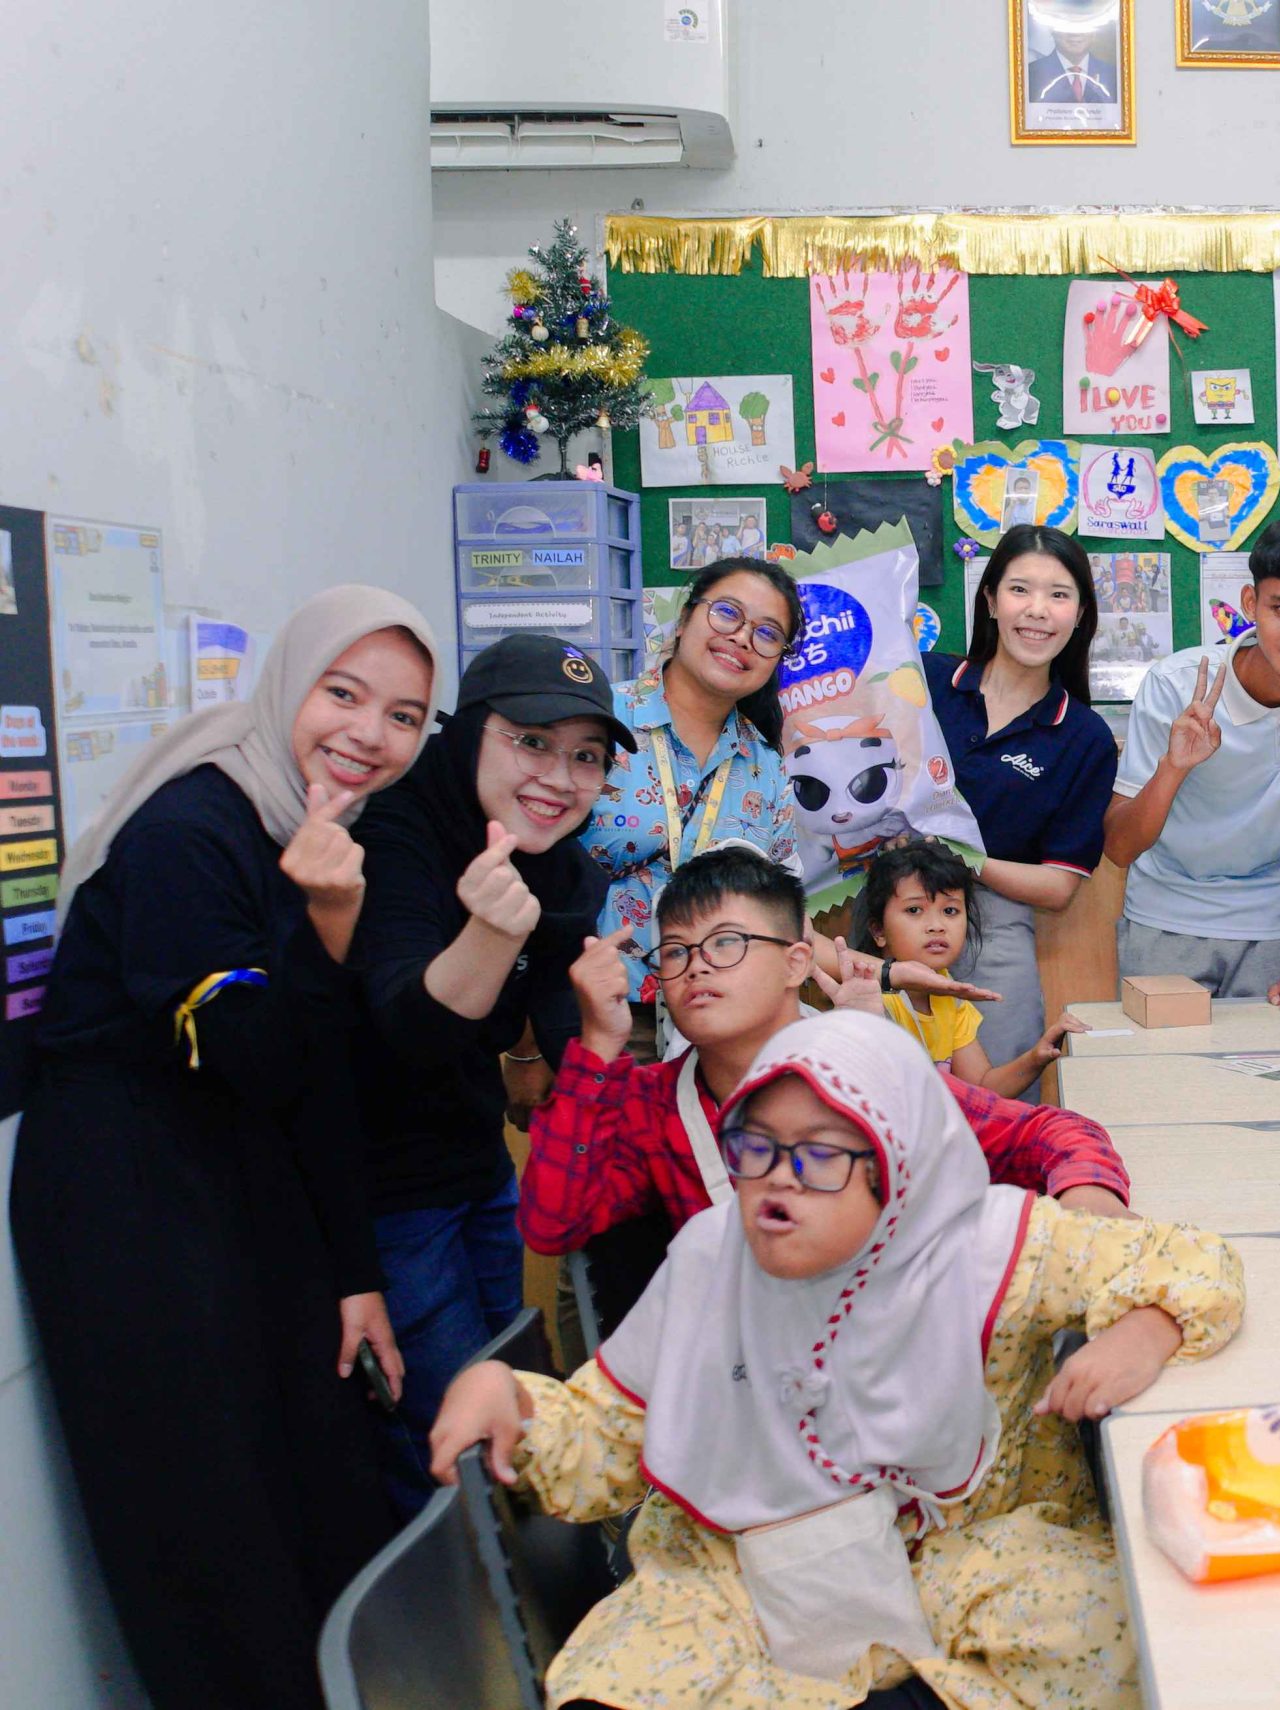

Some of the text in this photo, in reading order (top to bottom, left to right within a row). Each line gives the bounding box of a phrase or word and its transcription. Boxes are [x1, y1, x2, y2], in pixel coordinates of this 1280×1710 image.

[1092, 384, 1155, 412] LOVE
[473, 552, 583, 565] TRINITY NAILAH
[1000, 753, 1041, 776] Aice
